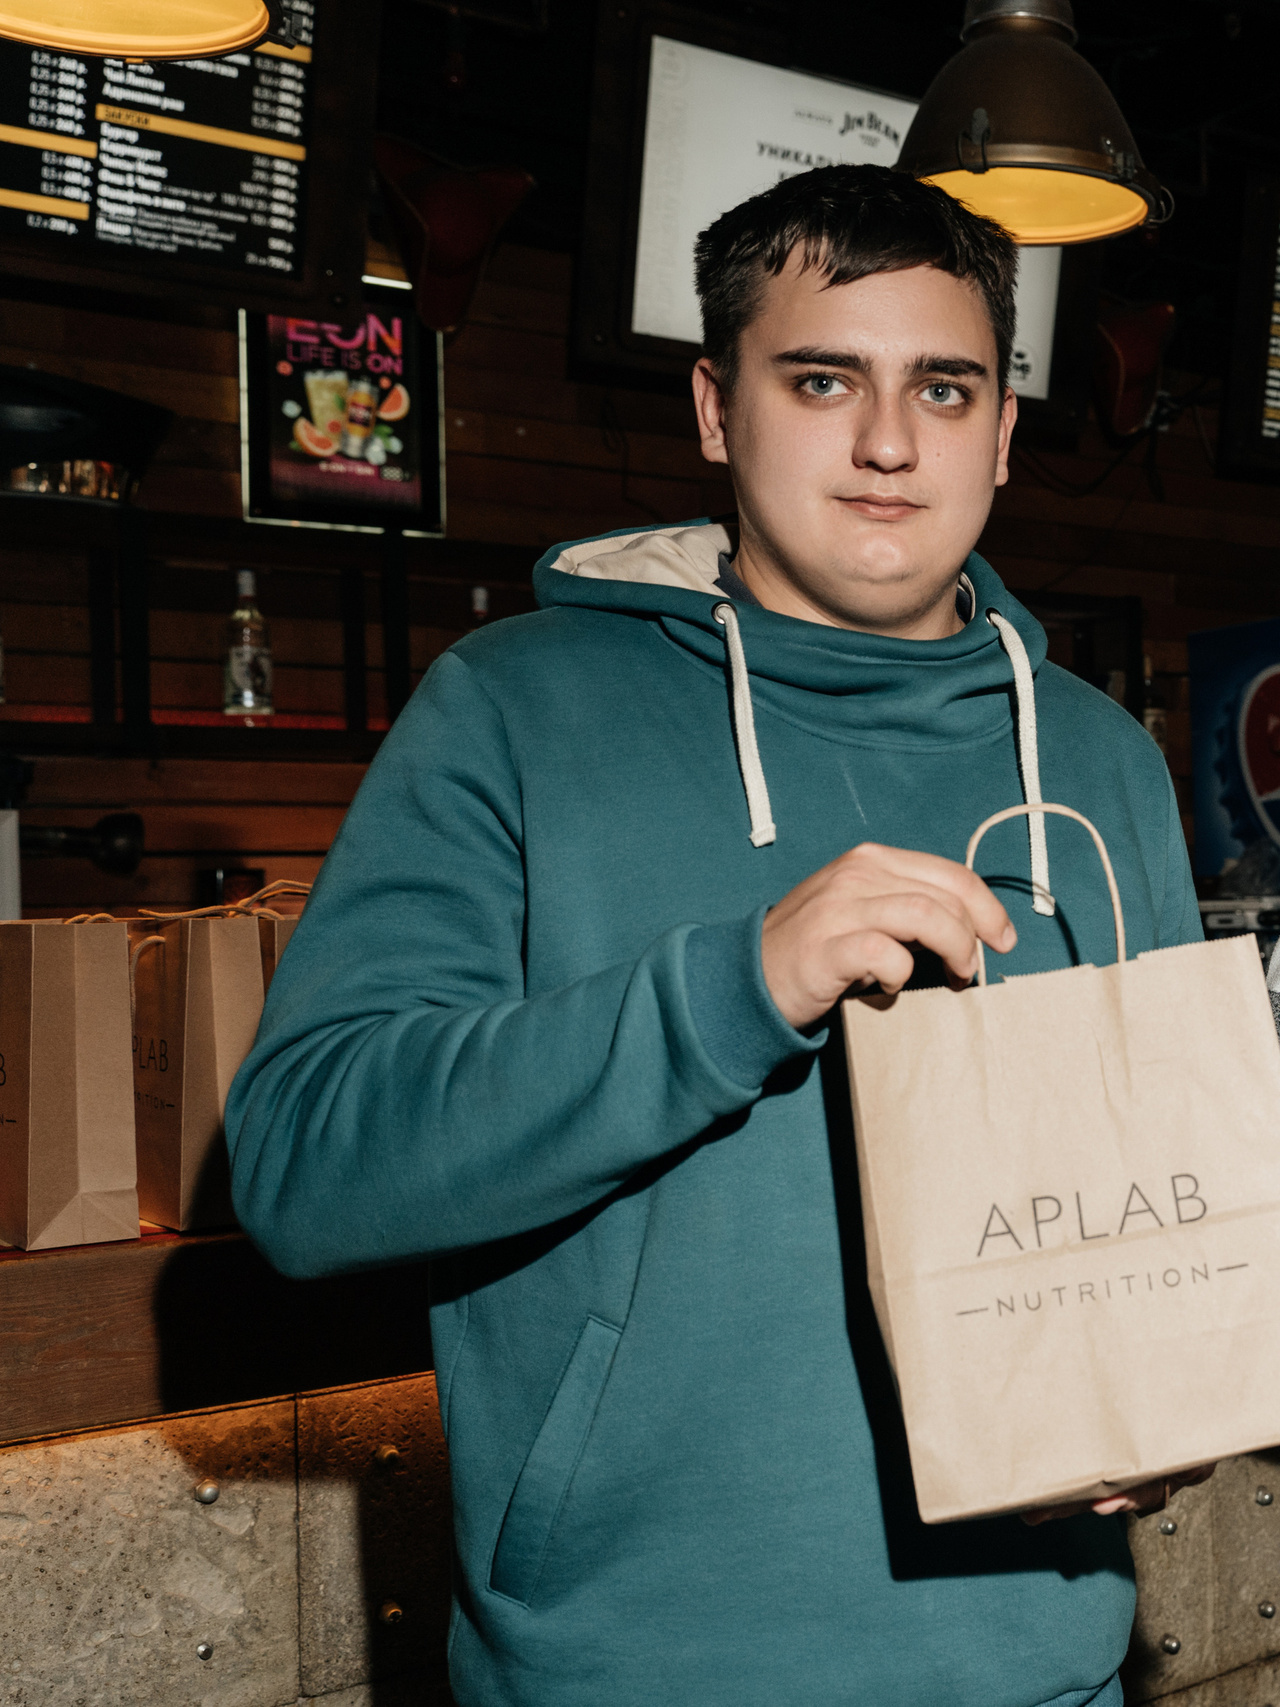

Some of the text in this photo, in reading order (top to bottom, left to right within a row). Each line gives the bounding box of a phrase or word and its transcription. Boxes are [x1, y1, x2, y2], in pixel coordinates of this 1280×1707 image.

[286, 343, 403, 375] LIFE IS ON
[132, 1036, 169, 1072] PLAB
[976, 1173, 1208, 1257] APLAB
[996, 1261, 1210, 1317] NUTRITION
